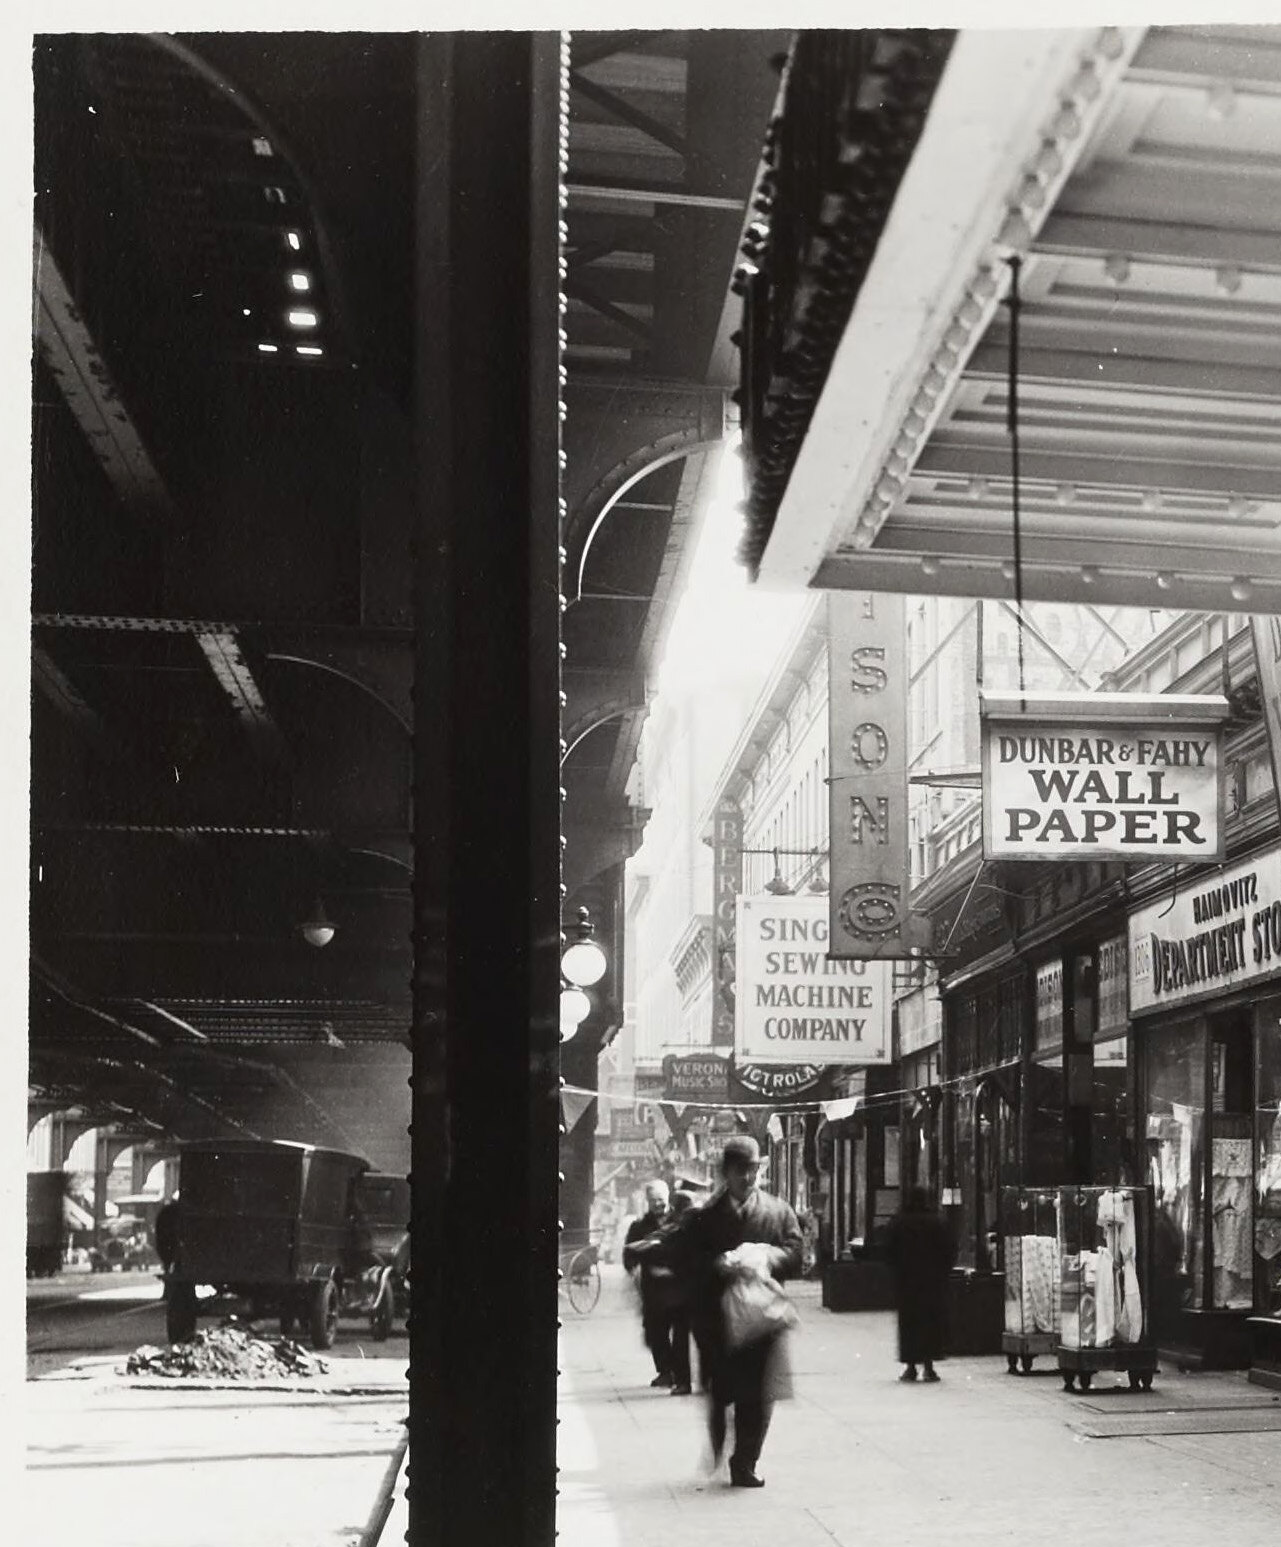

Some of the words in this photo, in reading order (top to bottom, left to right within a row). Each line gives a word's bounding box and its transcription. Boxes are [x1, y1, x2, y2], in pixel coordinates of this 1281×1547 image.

[998, 736, 1116, 766] DUNBAR
[1118, 744, 1135, 762] &
[1136, 739, 1212, 767] FAHY
[1028, 769, 1180, 806] WALL
[1004, 808, 1207, 845] PAPER
[765, 951, 867, 976] SEWING
[1150, 917, 1247, 996] DEPARTMENT
[755, 984, 873, 1009] MACHINE
[764, 1017, 868, 1042] COMPANY
